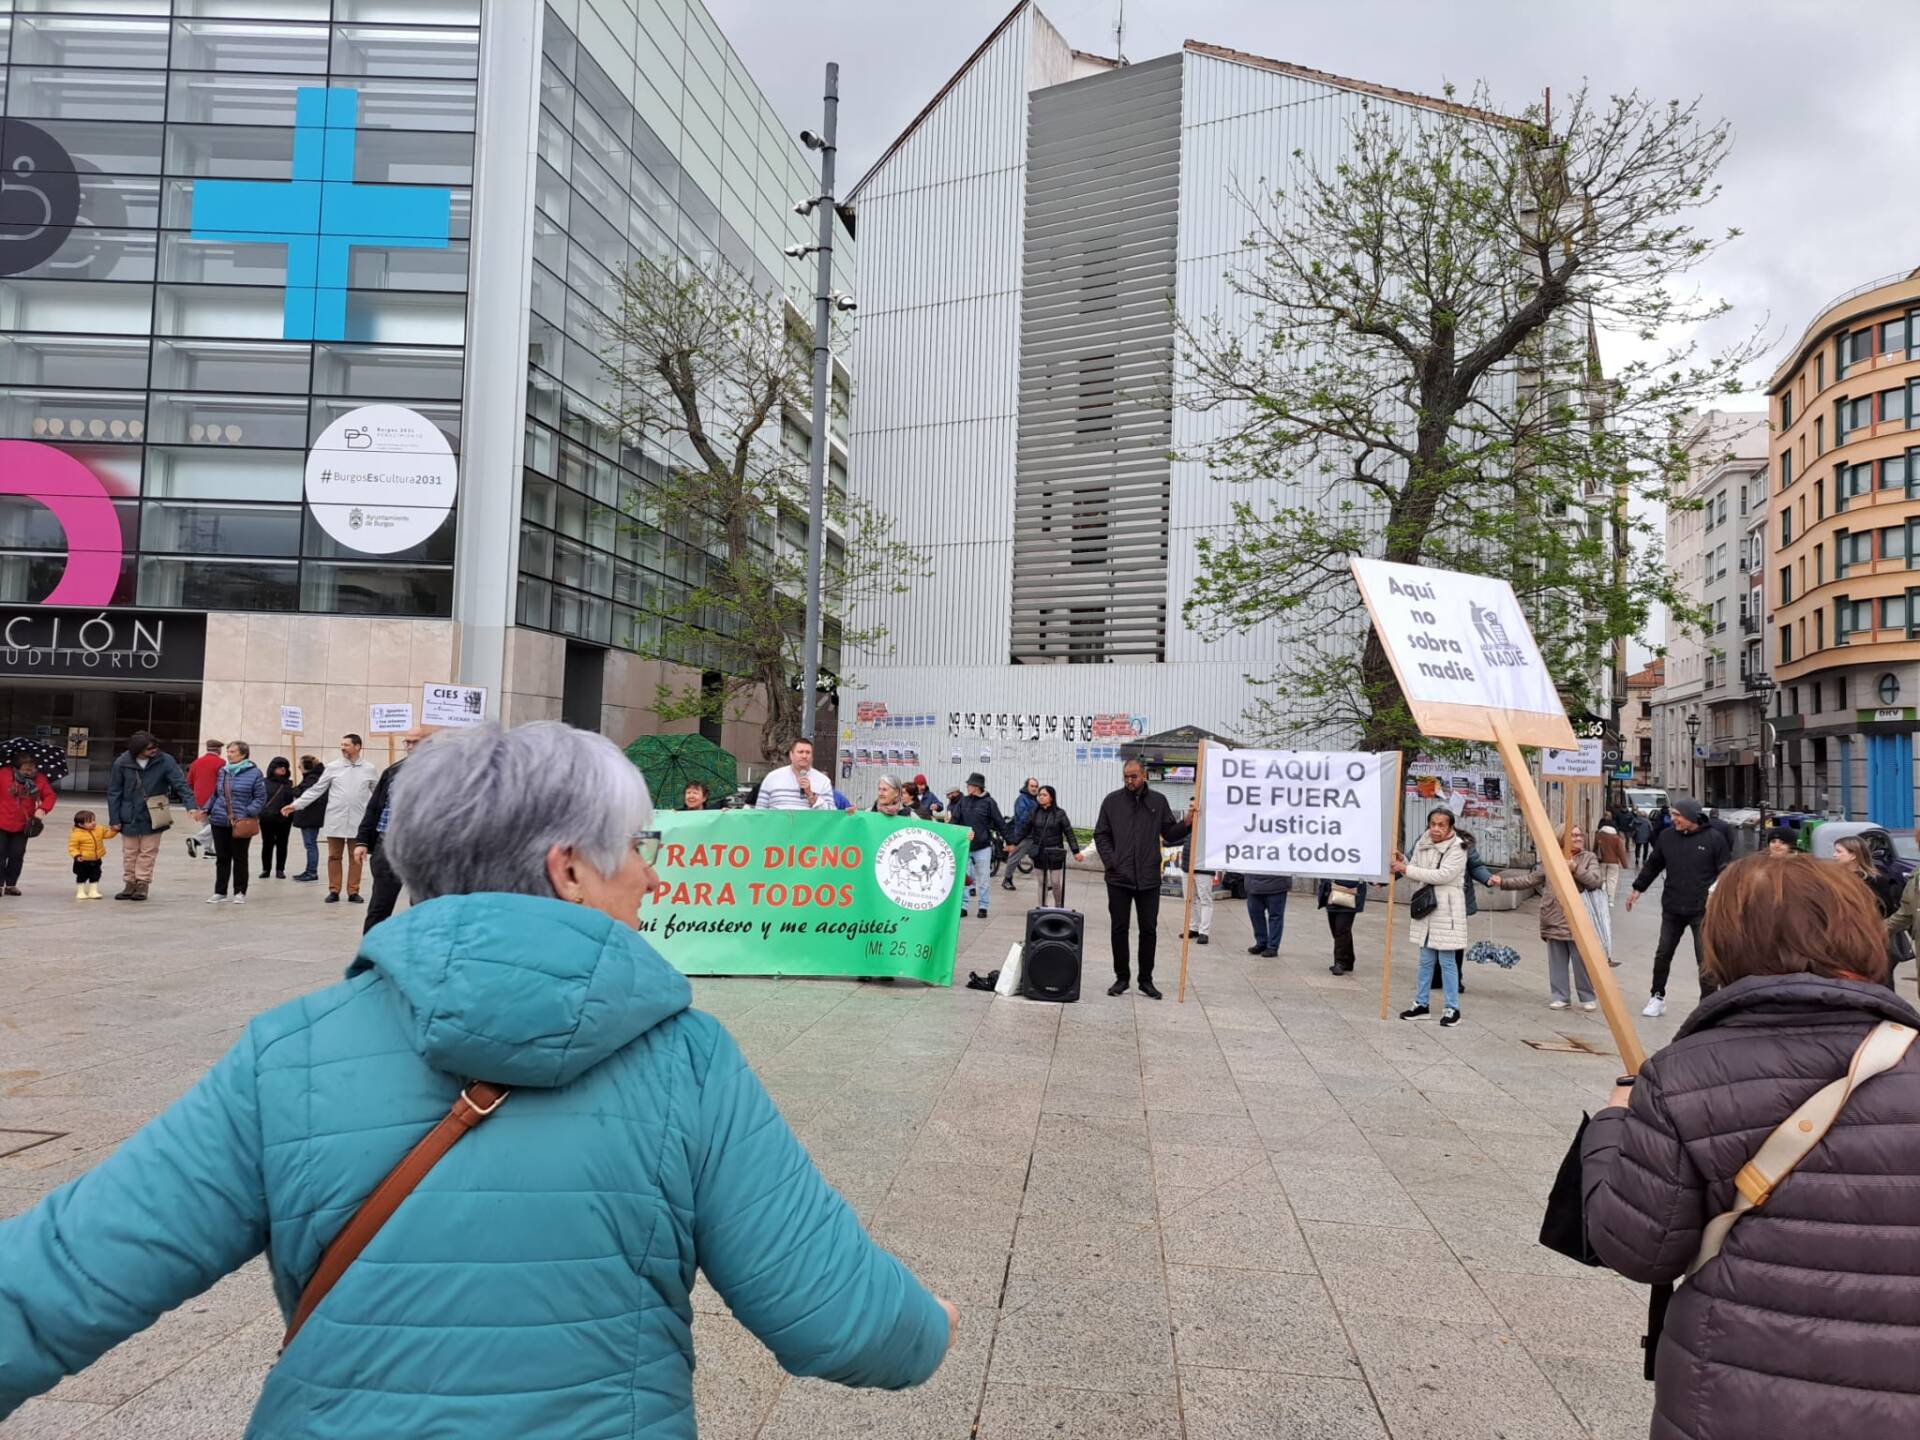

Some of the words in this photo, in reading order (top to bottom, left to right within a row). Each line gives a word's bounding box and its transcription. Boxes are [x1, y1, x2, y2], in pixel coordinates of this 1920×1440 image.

[320, 469, 442, 485] #BurgosEsCultura2031
[1388, 576, 1436, 600] Aquí
[1410, 609, 1436, 625] no
[5, 612, 163, 652] CIÓN
[1407, 631, 1463, 654] sobra
[1482, 650, 1529, 667] NADIE
[1418, 660, 1475, 682] nadie
[433, 689, 458, 699] CIES
[950, 712, 960, 724] NO
[965, 713, 976, 725] NO
[980, 713, 991, 726] NO
[996, 714, 1007, 726] NO
[1029, 714, 1040, 727] NO
[1046, 715, 1057, 728] NO
[1063, 716, 1075, 728] NO
[1081, 716, 1093, 729] NO
[1063, 729, 1075, 741] NO
[1080, 729, 1092, 742] NO
[1222, 758, 1256, 779] DE
[1265, 756, 1330, 781] AQUÍ
[1346, 762, 1366, 782] O
[1226, 785, 1261, 806] DE
[1271, 786, 1361, 809] FUERA
[1243, 813, 1342, 835] Justicia
[763, 845, 863, 869] DIGNO
[1225, 843, 1280, 864] para
[1288, 843, 1361, 864] todos
[652, 881, 736, 907] PARA
[749, 883, 855, 908] TODOS
[895, 896, 934, 910] BURGOS
[664, 913, 752, 939] forastero
[760, 921, 773, 937] y
[779, 921, 808, 934] me
